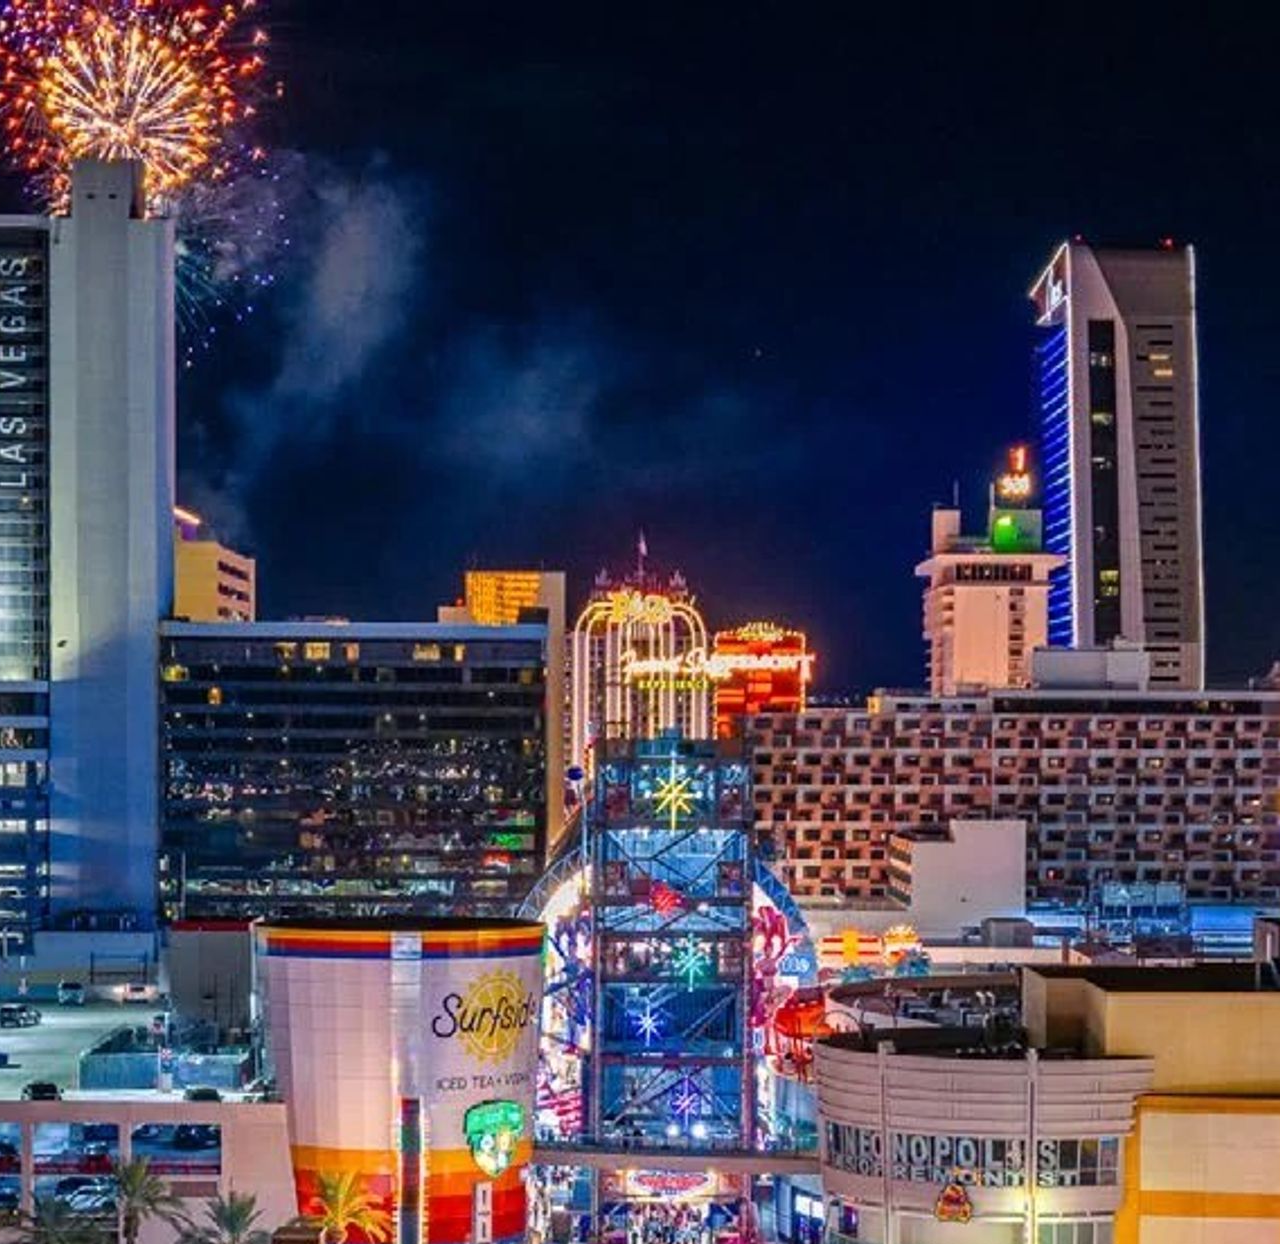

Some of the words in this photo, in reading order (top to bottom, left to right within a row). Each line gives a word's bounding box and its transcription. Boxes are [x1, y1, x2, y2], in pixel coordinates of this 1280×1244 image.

[437, 1077, 468, 1091] ICED
[472, 1075, 495, 1090] TEA
[1038, 1169, 1080, 1188] ST
